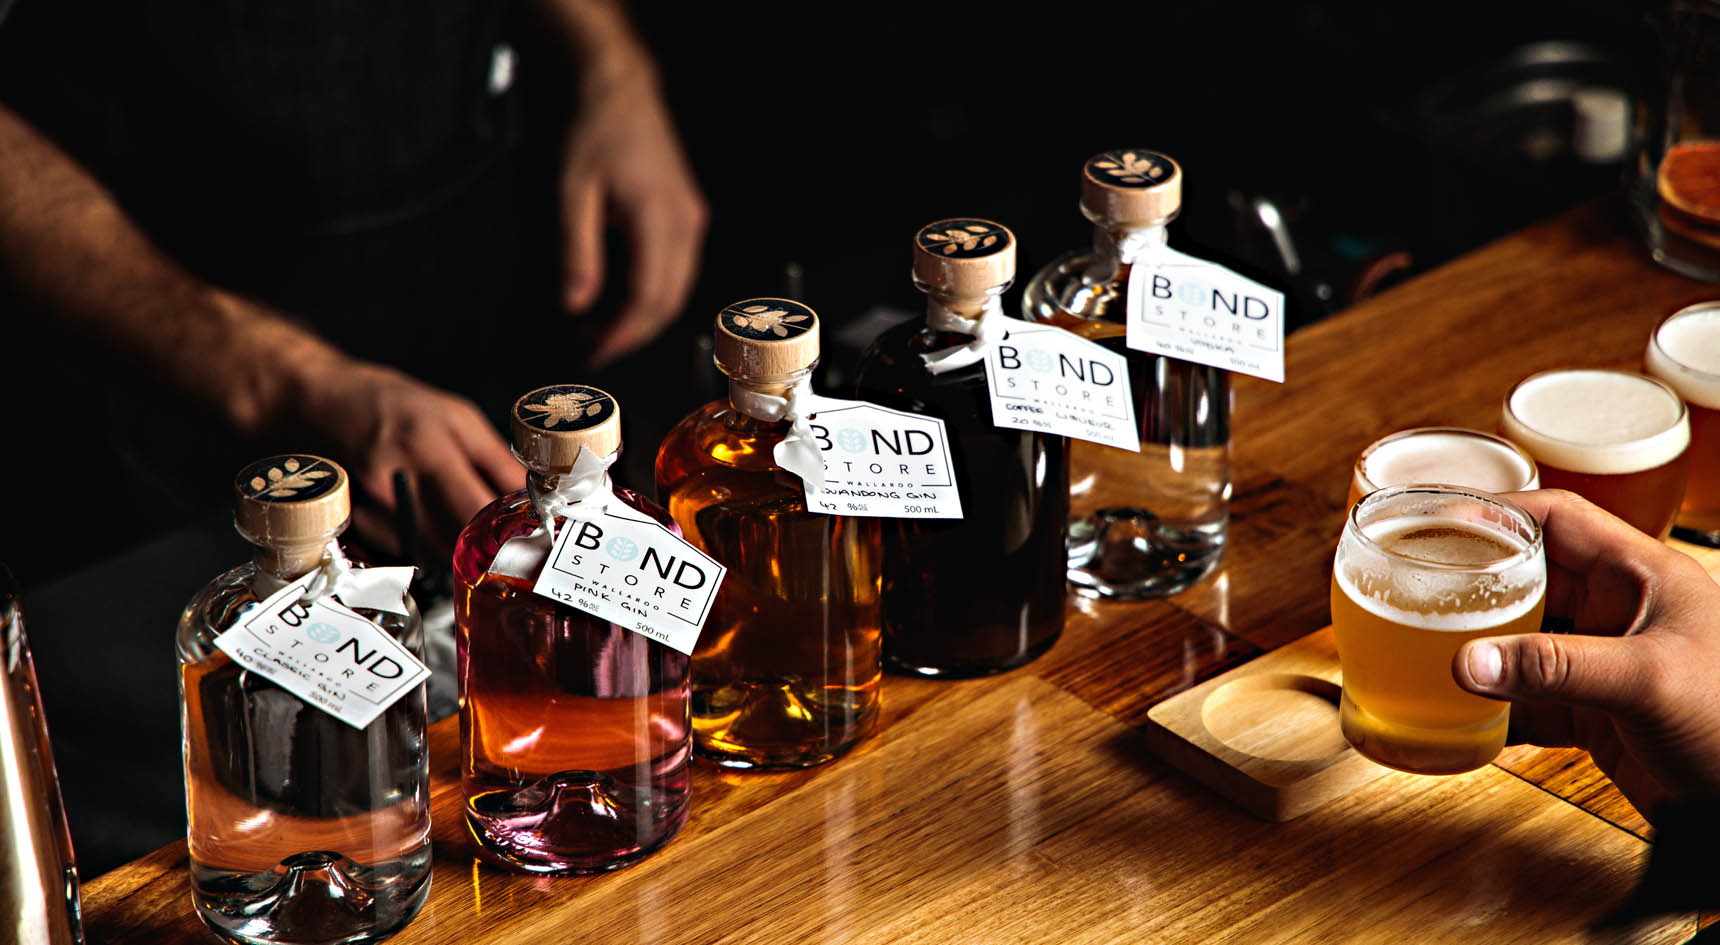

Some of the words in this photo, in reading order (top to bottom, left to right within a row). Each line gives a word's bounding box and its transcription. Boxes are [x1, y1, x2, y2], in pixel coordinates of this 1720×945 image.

[1152, 274, 1269, 320] BOND
[1155, 305, 1265, 339] STORE
[999, 346, 1114, 386] BOND
[1007, 377, 1114, 407] STORE
[1012, 416, 1029, 425] 20
[810, 424, 934, 456] BOND
[846, 480, 914, 488] WALLAROO
[906, 492, 937, 500] GIN
[819, 501, 837, 511] 42
[904, 505, 922, 513] 500
[924, 505, 939, 514] mL
[575, 521, 706, 590] BOND
[551, 588, 573, 603] 42
[572, 555, 692, 610] STORE
[592, 579, 660, 611] WALLAROO
[574, 582, 611, 602] PINK
[620, 601, 648, 618] GIN
[278, 600, 404, 679] BOND
[635, 621, 654, 635] 500
[656, 631, 671, 643] mL
[265, 624, 380, 692] STORE
